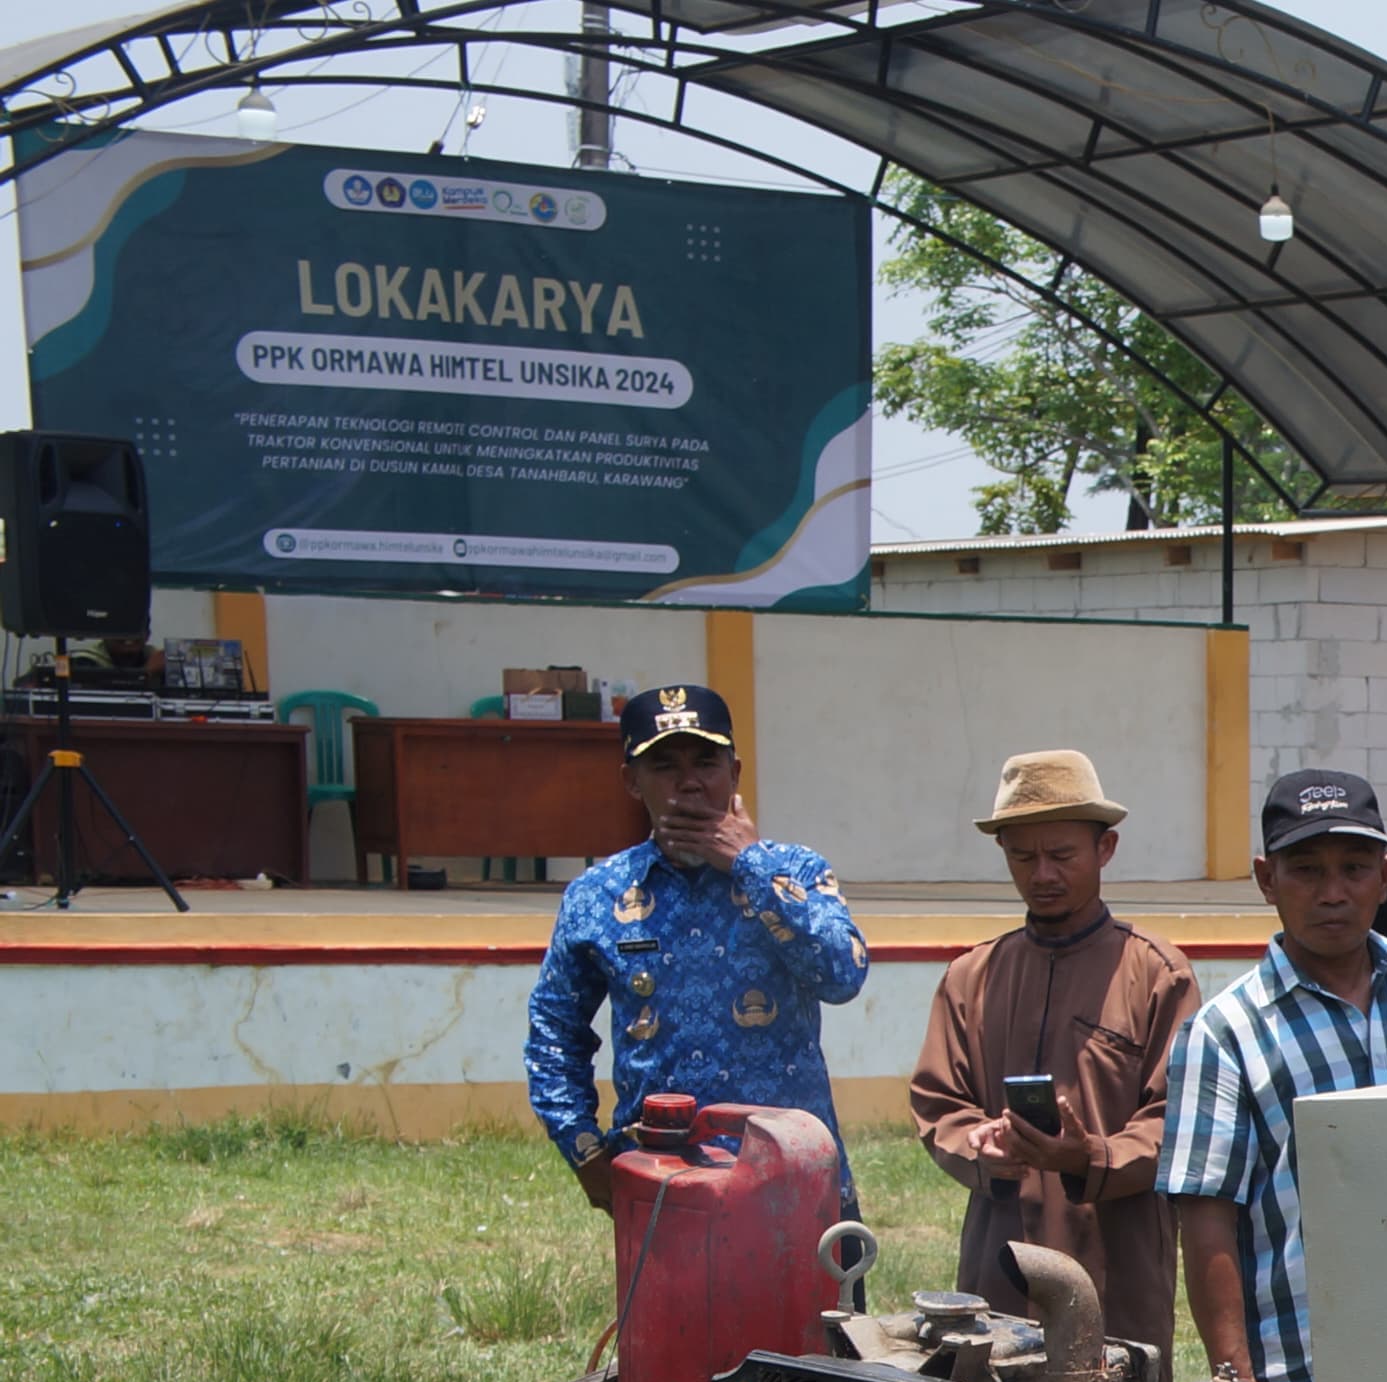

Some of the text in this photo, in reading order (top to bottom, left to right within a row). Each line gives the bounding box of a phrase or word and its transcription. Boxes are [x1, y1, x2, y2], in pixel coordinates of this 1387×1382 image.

[298, 260, 645, 339] LOKAKARYA
[252, 344, 675, 396] PPK ORMAWA HIMTEL UNSIKA 2024
[247, 433, 699, 471] TRAKTOR KONVENSIONAL UNTUK MENINGKATKAN PRODUKTIVITAS
[334, 416, 414, 433] TEKNOLOGI
[418, 420, 465, 436] REMOTE
[468, 423, 539, 441] CONTROL
[544, 428, 576, 443] DAN
[579, 431, 622, 446] PANEL
[625, 434, 668, 449] SURYA
[671, 437, 710, 452] PADA
[262, 455, 345, 472] PERTANIAN
[350, 459, 366, 472] DI
[370, 459, 418, 474] DUSUN
[466, 464, 504, 478] DESA
[509, 466, 600, 485] TANAHBARU,
[1299, 785, 1347, 803] Jeep
